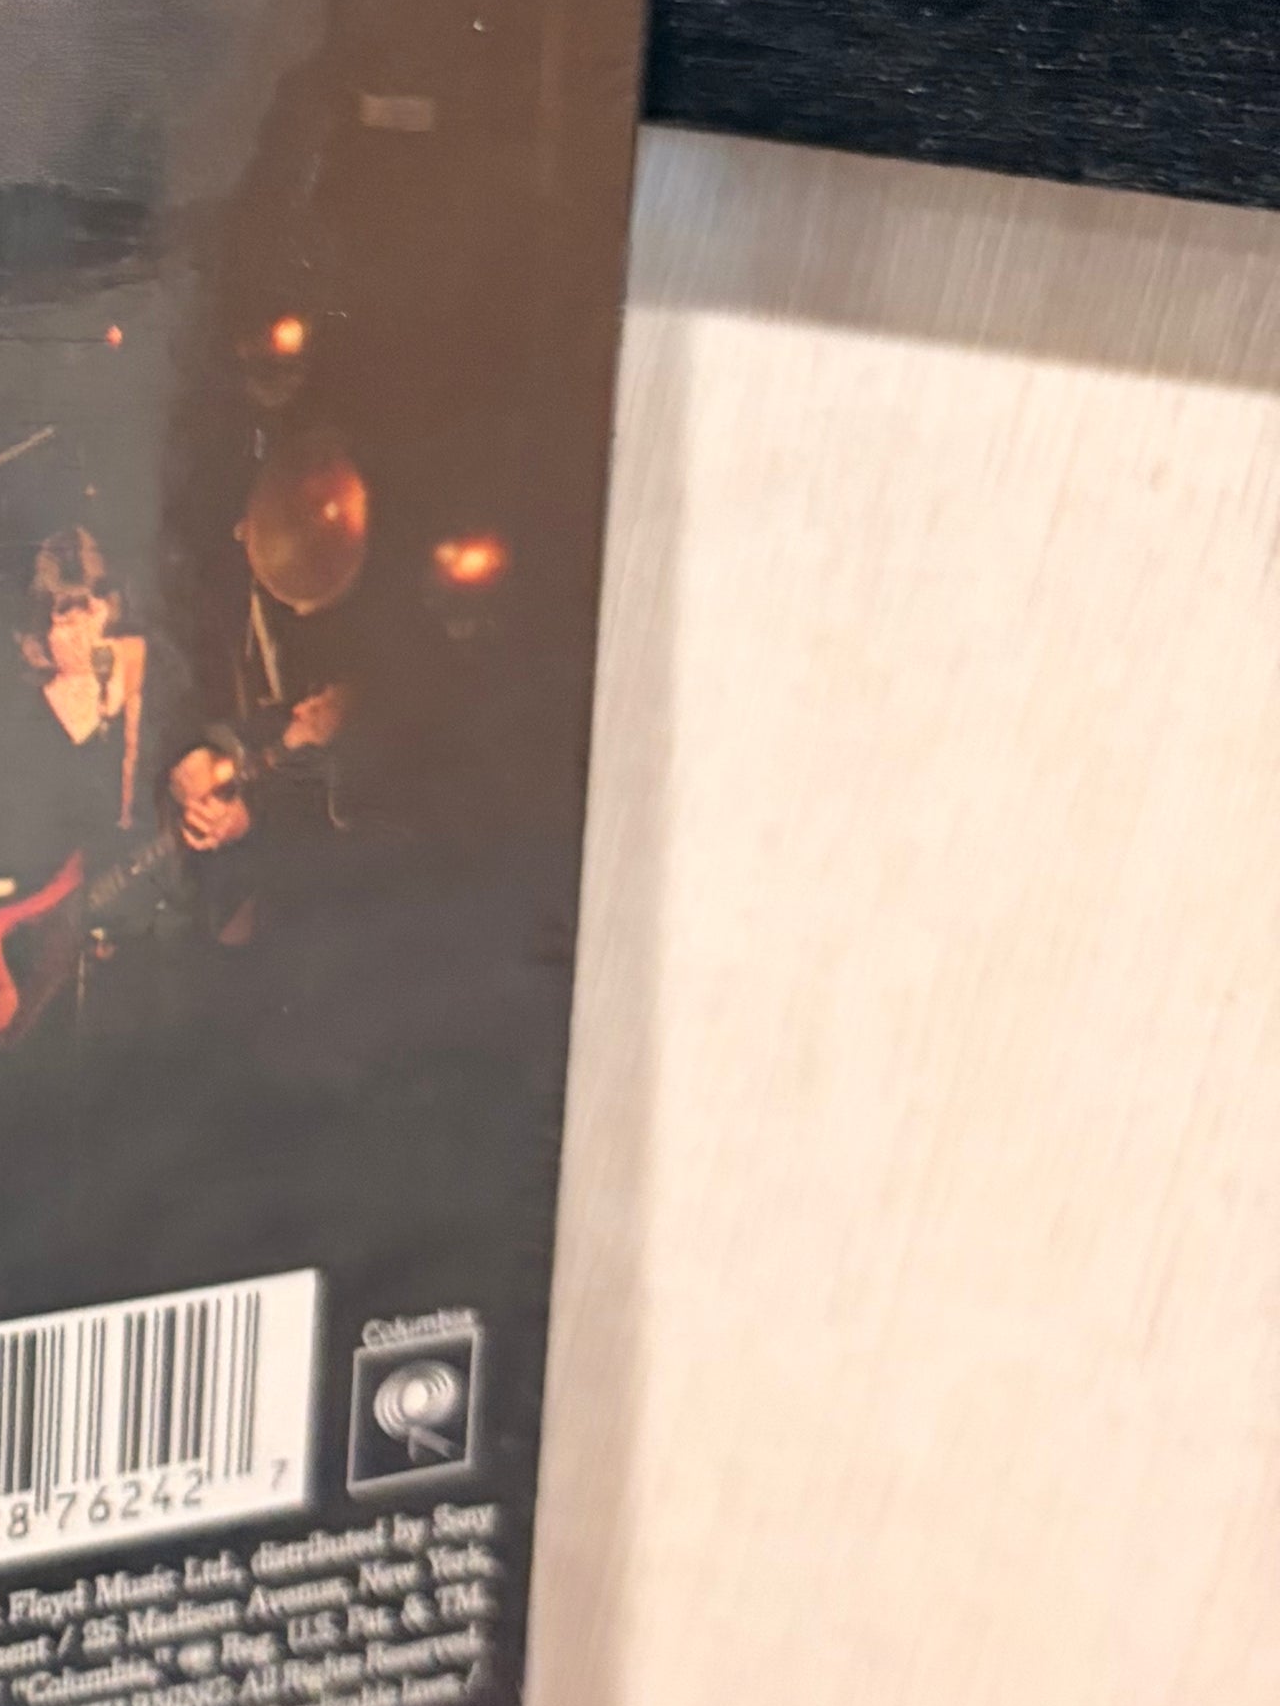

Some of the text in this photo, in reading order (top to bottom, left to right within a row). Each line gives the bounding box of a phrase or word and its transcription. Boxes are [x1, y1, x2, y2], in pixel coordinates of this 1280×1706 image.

[55, 1466, 206, 1532] 76242
[268, 1459, 291, 1490] 7
[9, 1577, 89, 1627] Floyd
[94, 1564, 180, 1607] Music
[251, 1518, 387, 1577] distributed
[391, 1512, 430, 1551] by
[127, 1598, 241, 1642] Madison
[357, 1559, 426, 1595] New
